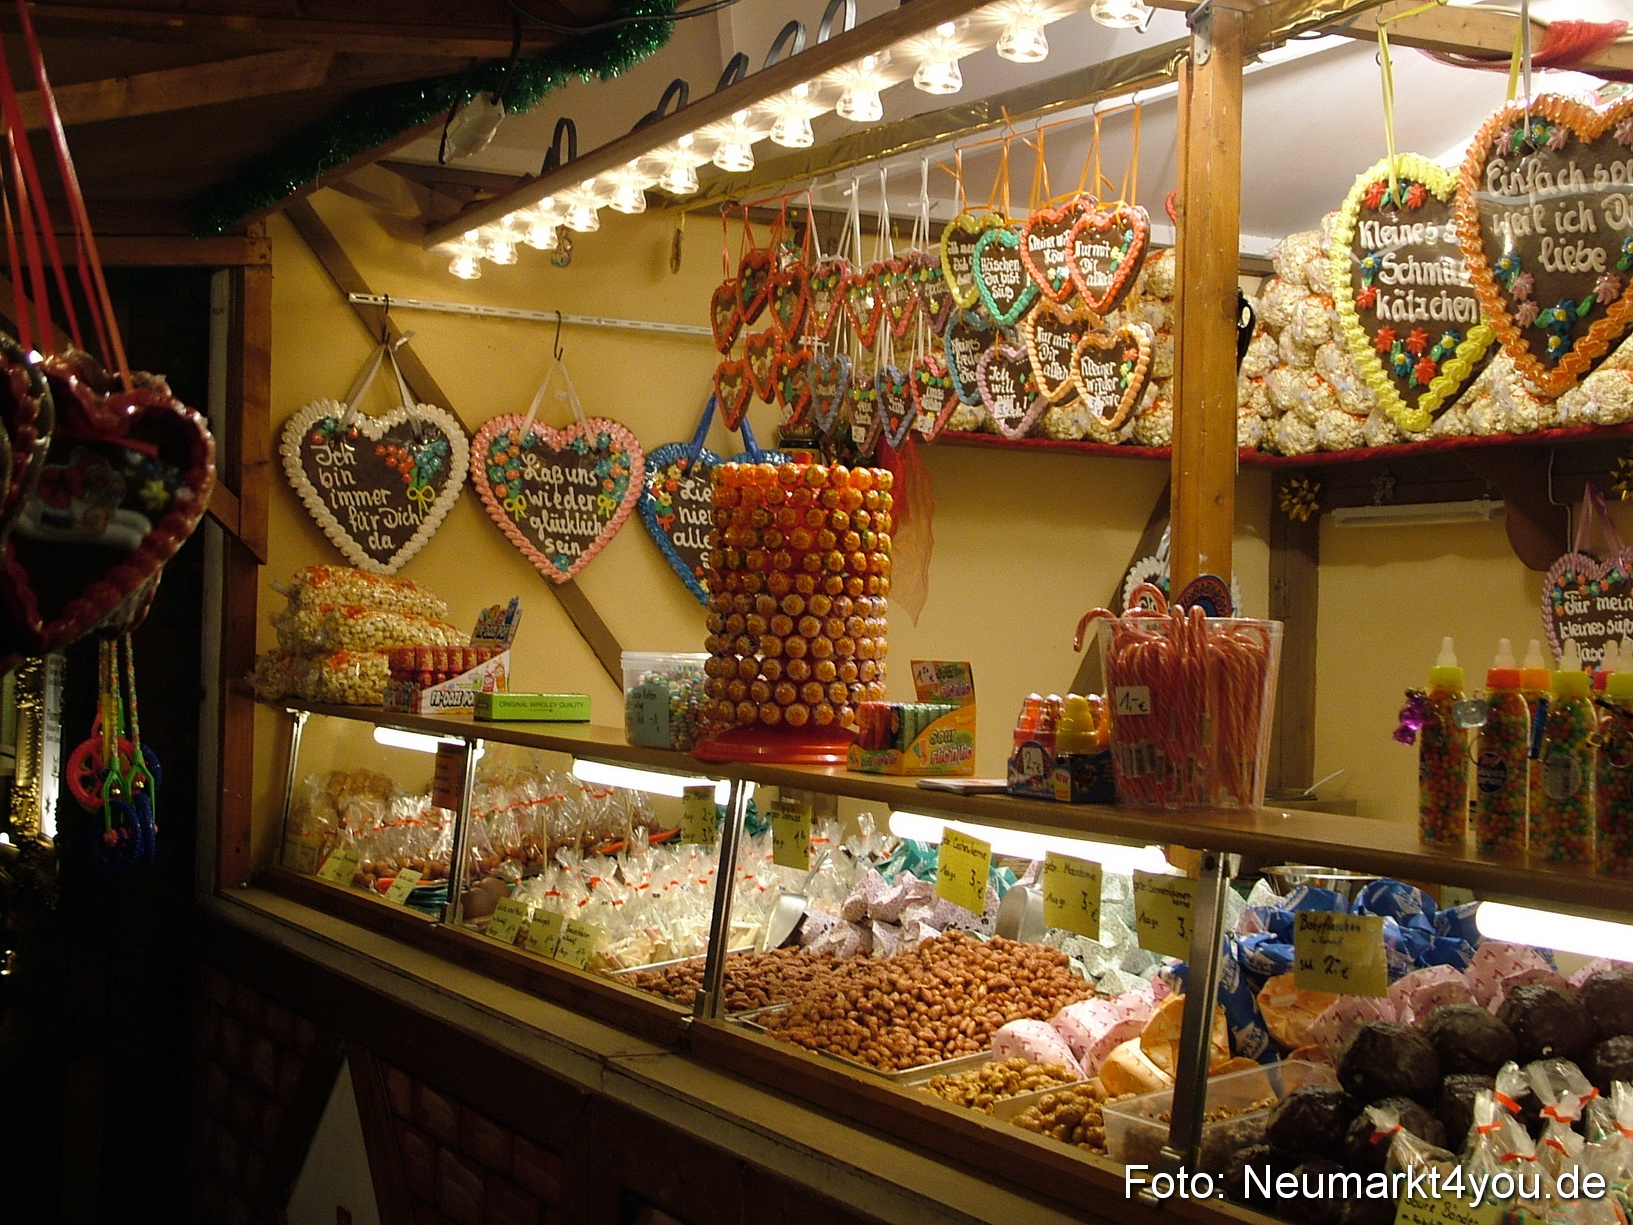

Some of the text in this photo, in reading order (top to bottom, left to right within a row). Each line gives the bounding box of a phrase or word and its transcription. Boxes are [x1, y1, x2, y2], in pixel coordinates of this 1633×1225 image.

[1555, 201, 1597, 233] ich
[1539, 237, 1606, 273] liebe
[1038, 343, 1060, 361] Dir
[991, 379, 1015, 394] will
[310, 445, 356, 466] Ich
[318, 468, 355, 488] bin
[565, 469, 599, 488] uns
[330, 488, 393, 507] immer
[525, 488, 597, 511] wieder
[347, 505, 421, 531] für Dich
[368, 529, 396, 550] da
[544, 537, 582, 557] sein
[559, 701, 583, 709] QUALITY
